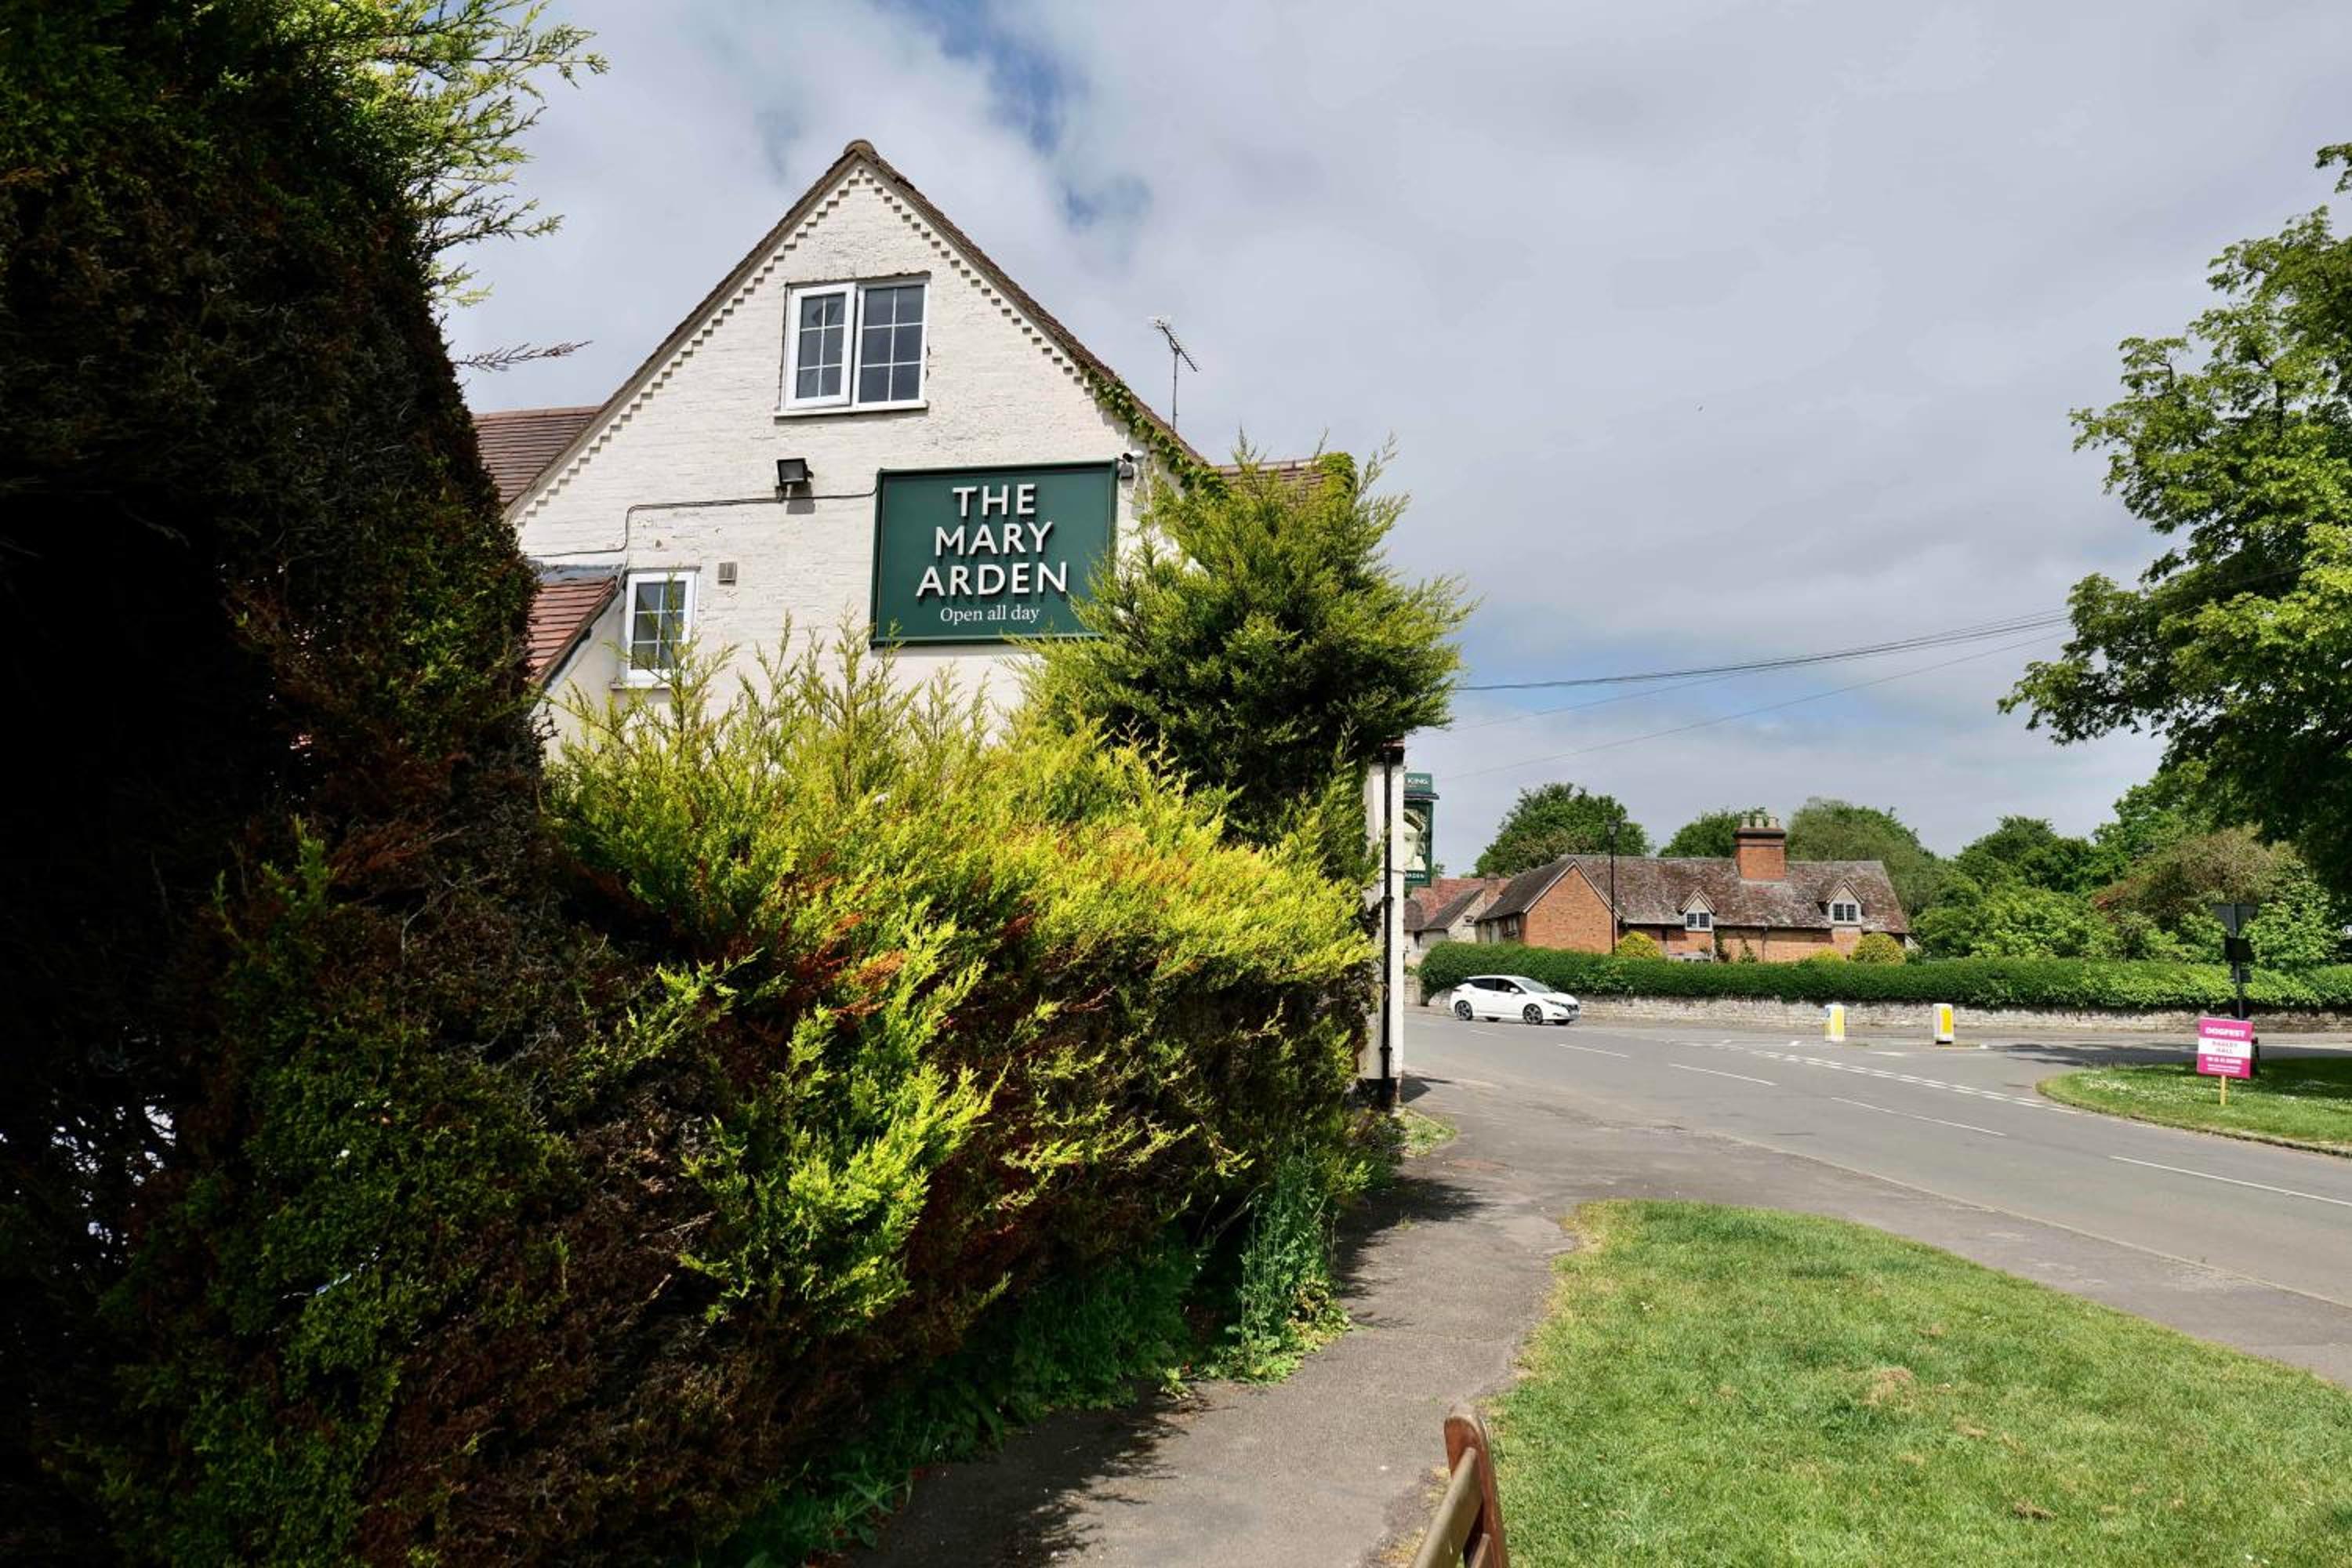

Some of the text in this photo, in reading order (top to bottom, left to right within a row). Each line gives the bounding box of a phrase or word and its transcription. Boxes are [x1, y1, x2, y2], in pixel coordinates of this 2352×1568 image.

[953, 483, 1036, 517] THE
[935, 521, 1053, 557] MARY
[916, 561, 1067, 597] ARDEN
[940, 603, 1040, 626] Open all day
